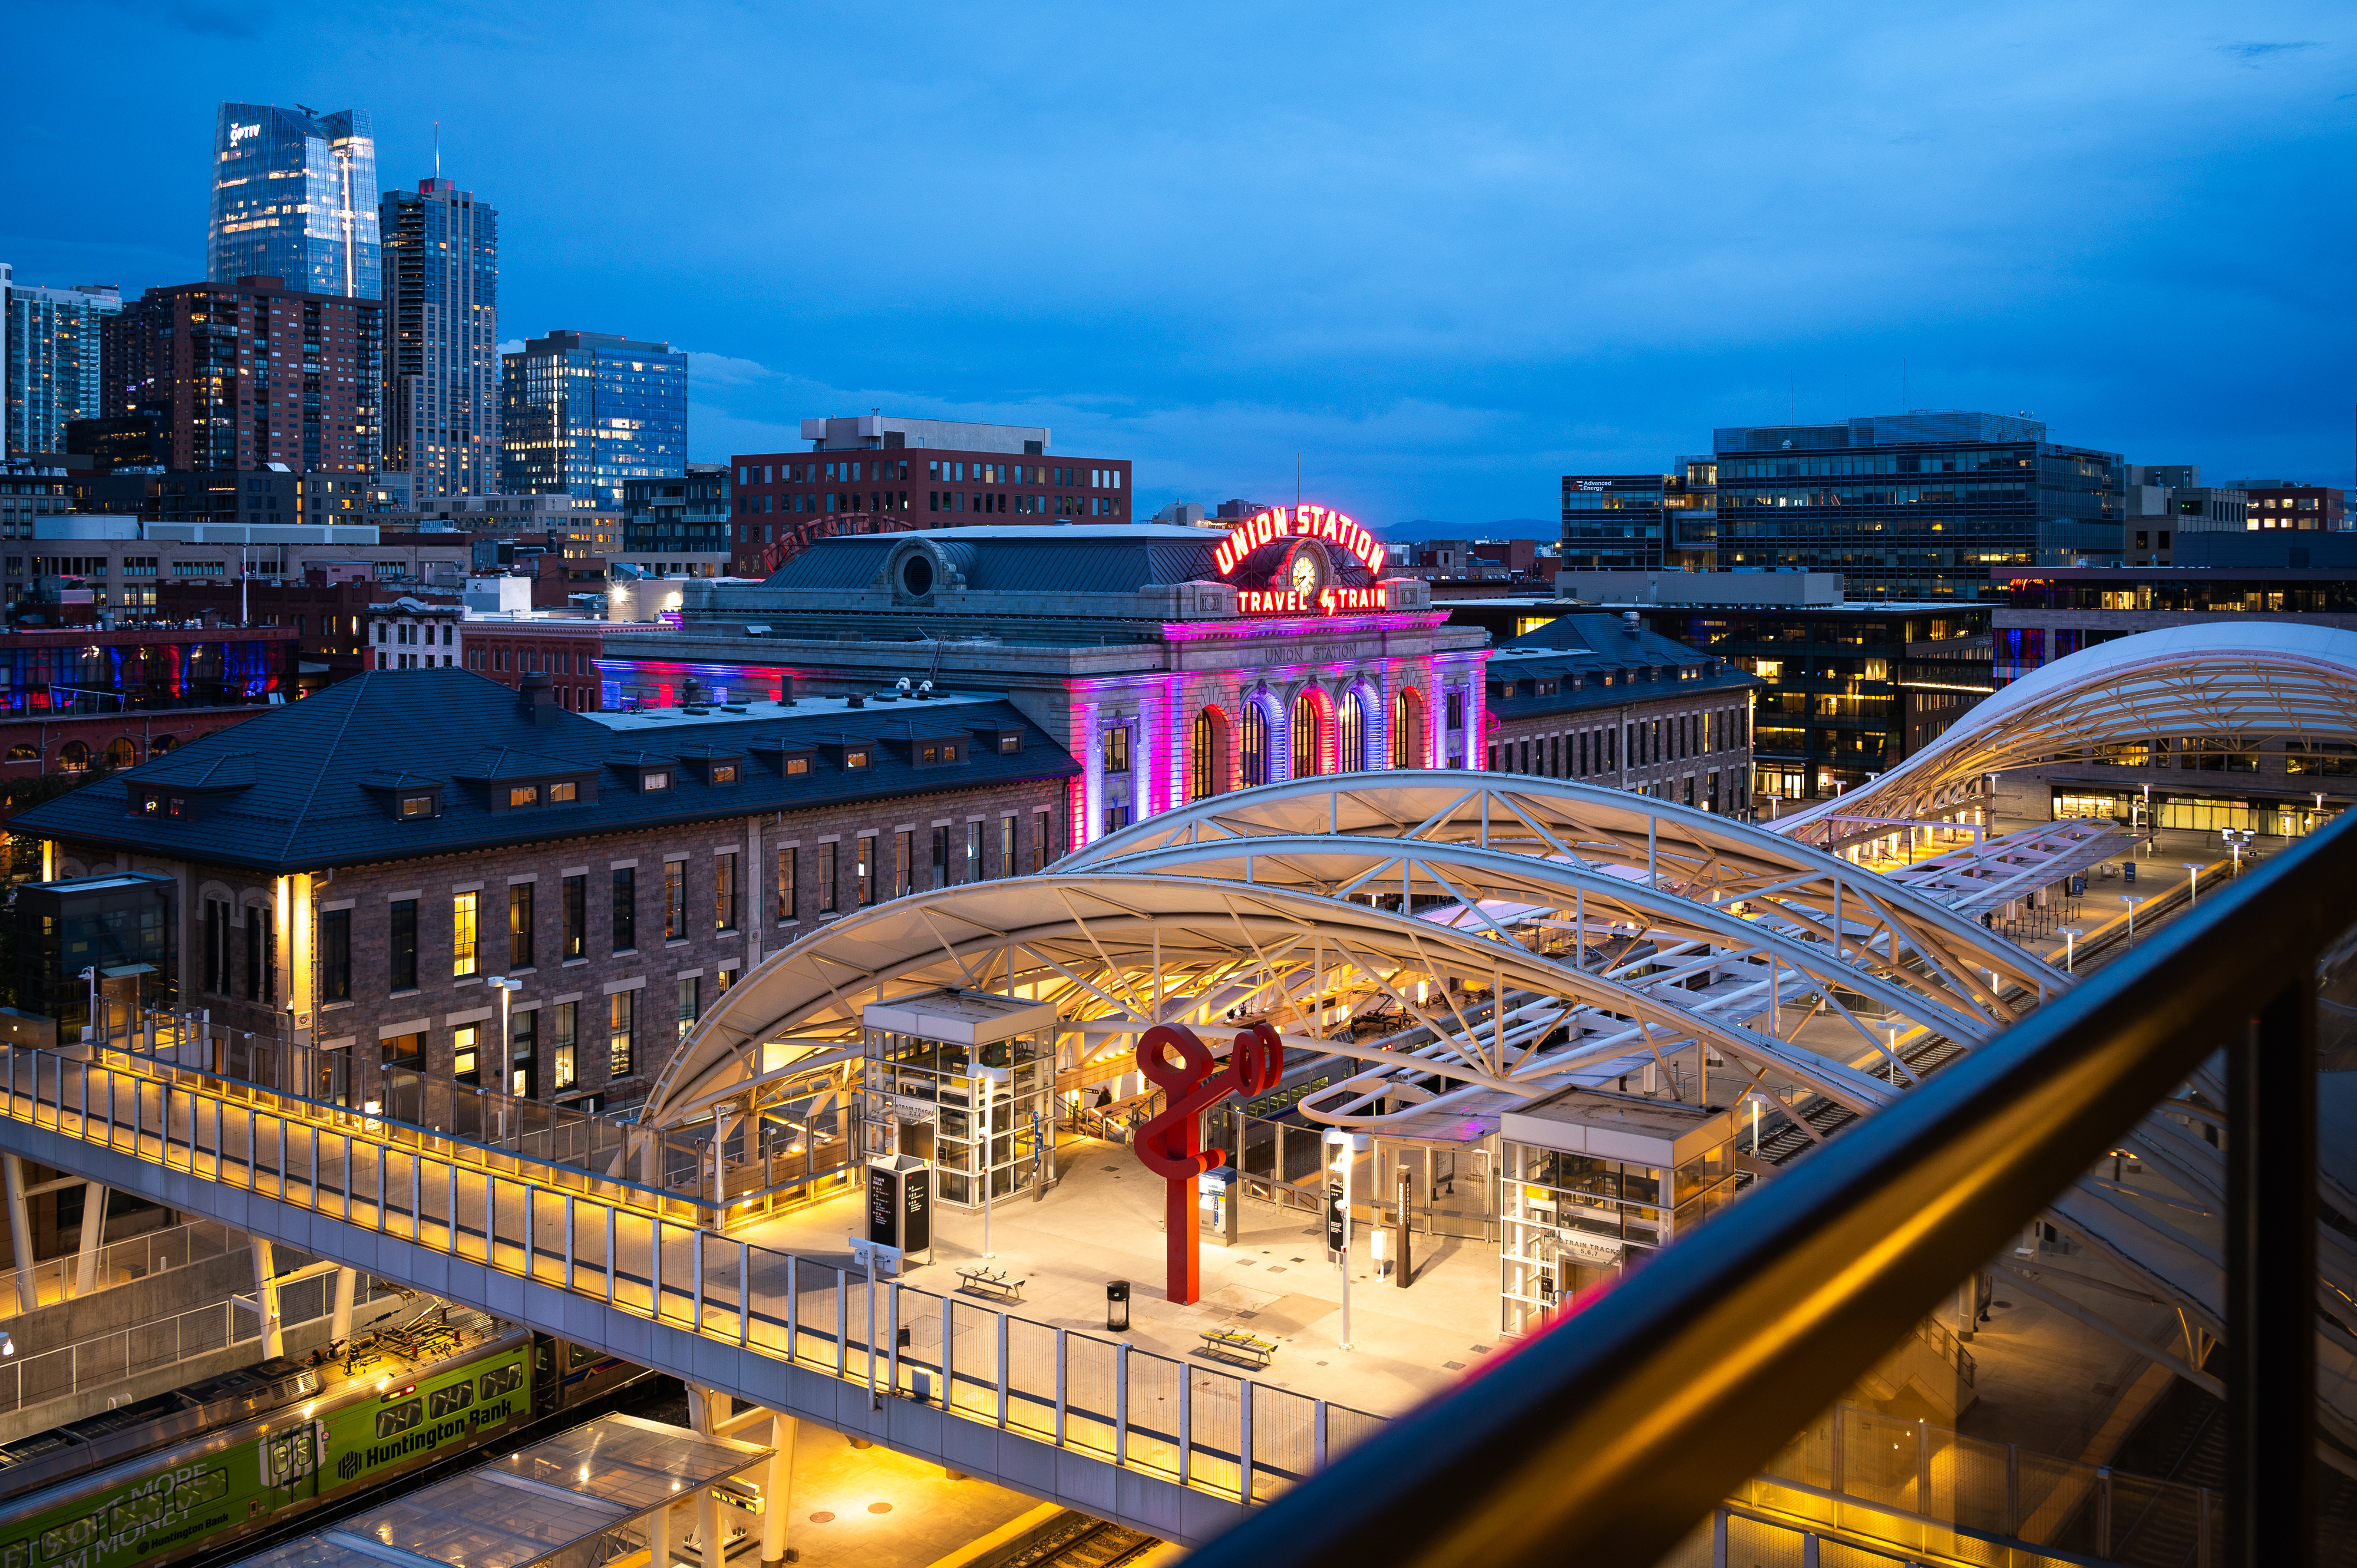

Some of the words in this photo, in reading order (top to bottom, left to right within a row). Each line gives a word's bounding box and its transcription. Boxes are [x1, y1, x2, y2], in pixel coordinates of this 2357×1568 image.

[230, 123, 260, 142] OPTIV
[1214, 506, 1288, 575] UNION
[1296, 505, 1385, 575] STATION
[1238, 590, 1308, 612] TRAVEL
[1319, 587, 1336, 616] by
[1338, 588, 1385, 609] TRAIN
[1265, 647, 1303, 663] UNION
[1313, 644, 1357, 659] STATION
[1565, 1239, 1587, 1248] TRAIN
[1589, 1244, 1620, 1255] TRACKS
[1580, 1249, 1598, 1257] 5,6,7
[367, 1417, 466, 1468] Huntington
[469, 1399, 512, 1427] Bank
[69, 1495, 124, 1544] GET
[130, 1463, 209, 1511] MORE
[95, 1496, 194, 1564] MONEY
[151, 1522, 204, 1550] Huntington
[205, 1512, 229, 1529] Bank
